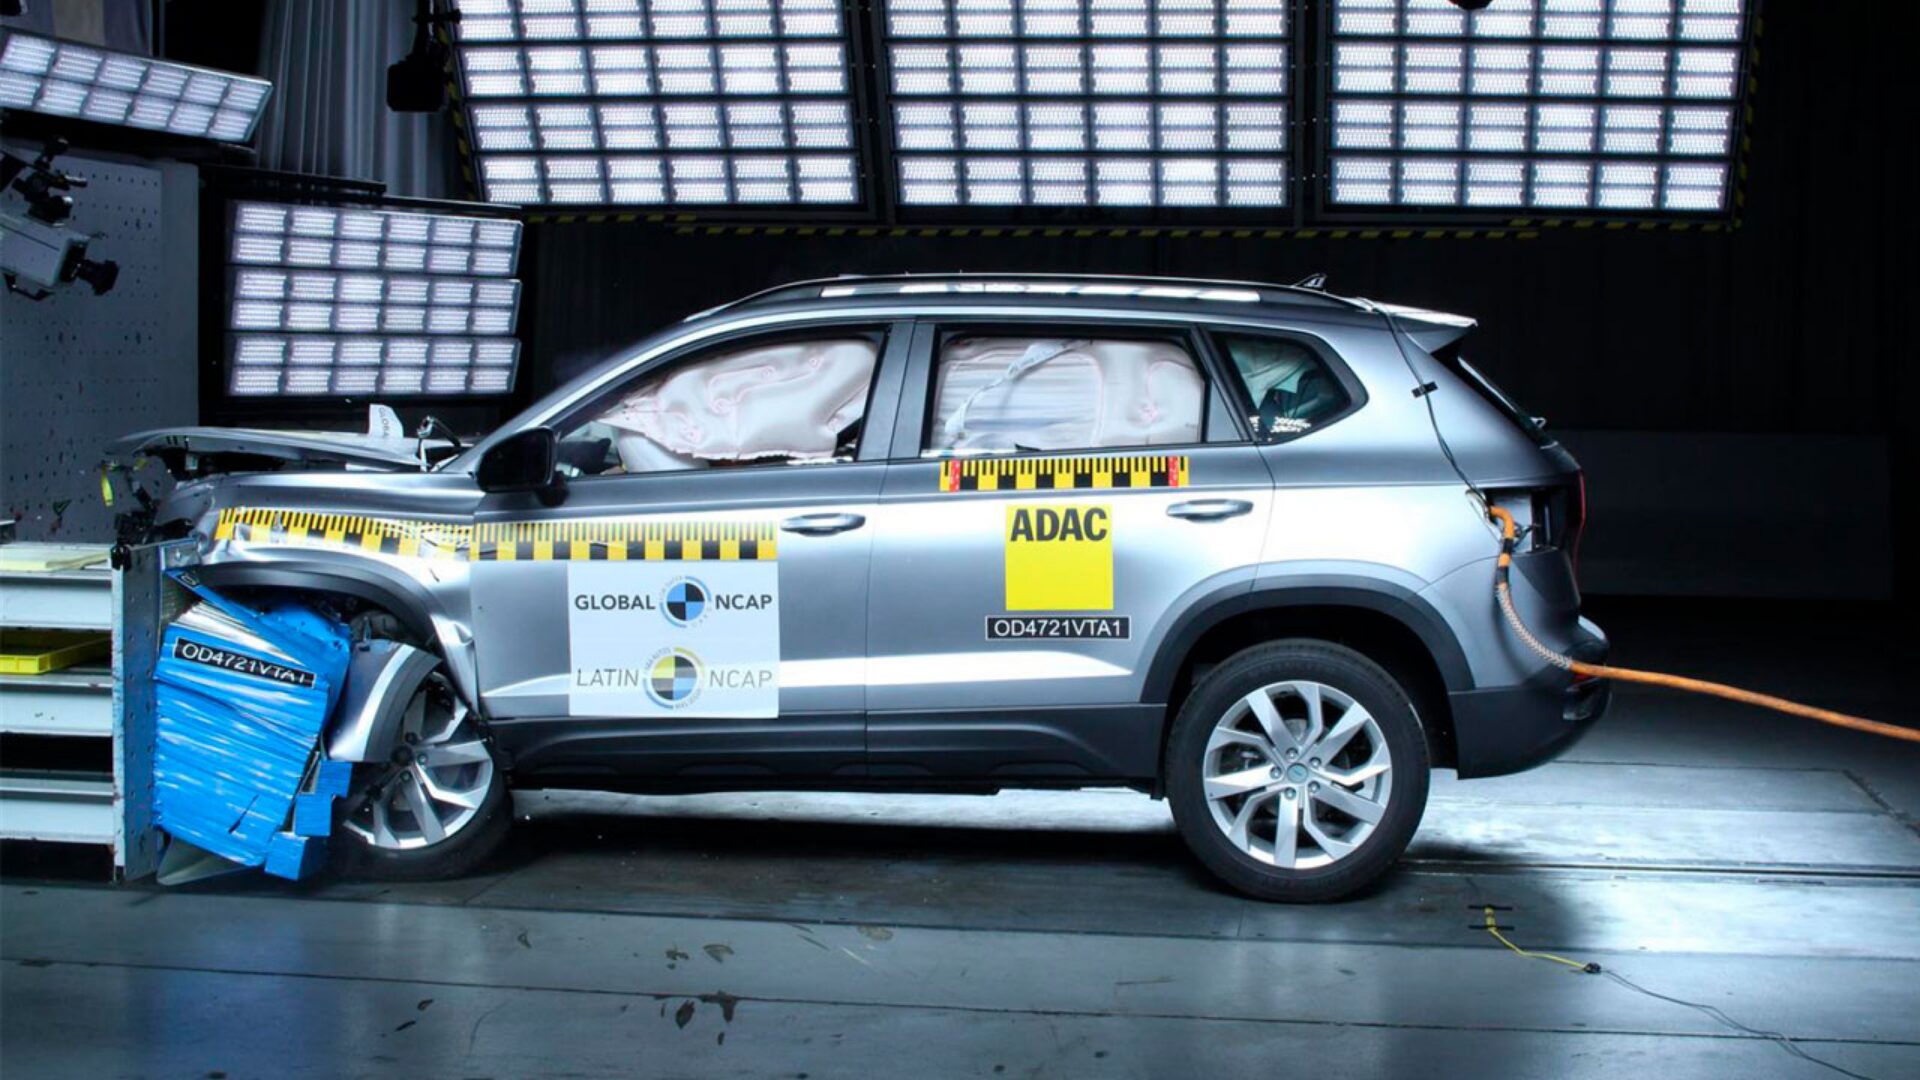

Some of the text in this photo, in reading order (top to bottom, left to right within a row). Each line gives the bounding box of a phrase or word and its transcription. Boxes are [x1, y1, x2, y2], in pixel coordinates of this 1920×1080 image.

[1010, 508, 1108, 541] ADAC
[575, 594, 773, 611] GLOBAL NCAP
[994, 619, 1120, 637] OD4721VTA1
[576, 669, 773, 689] LATIN NCAP
